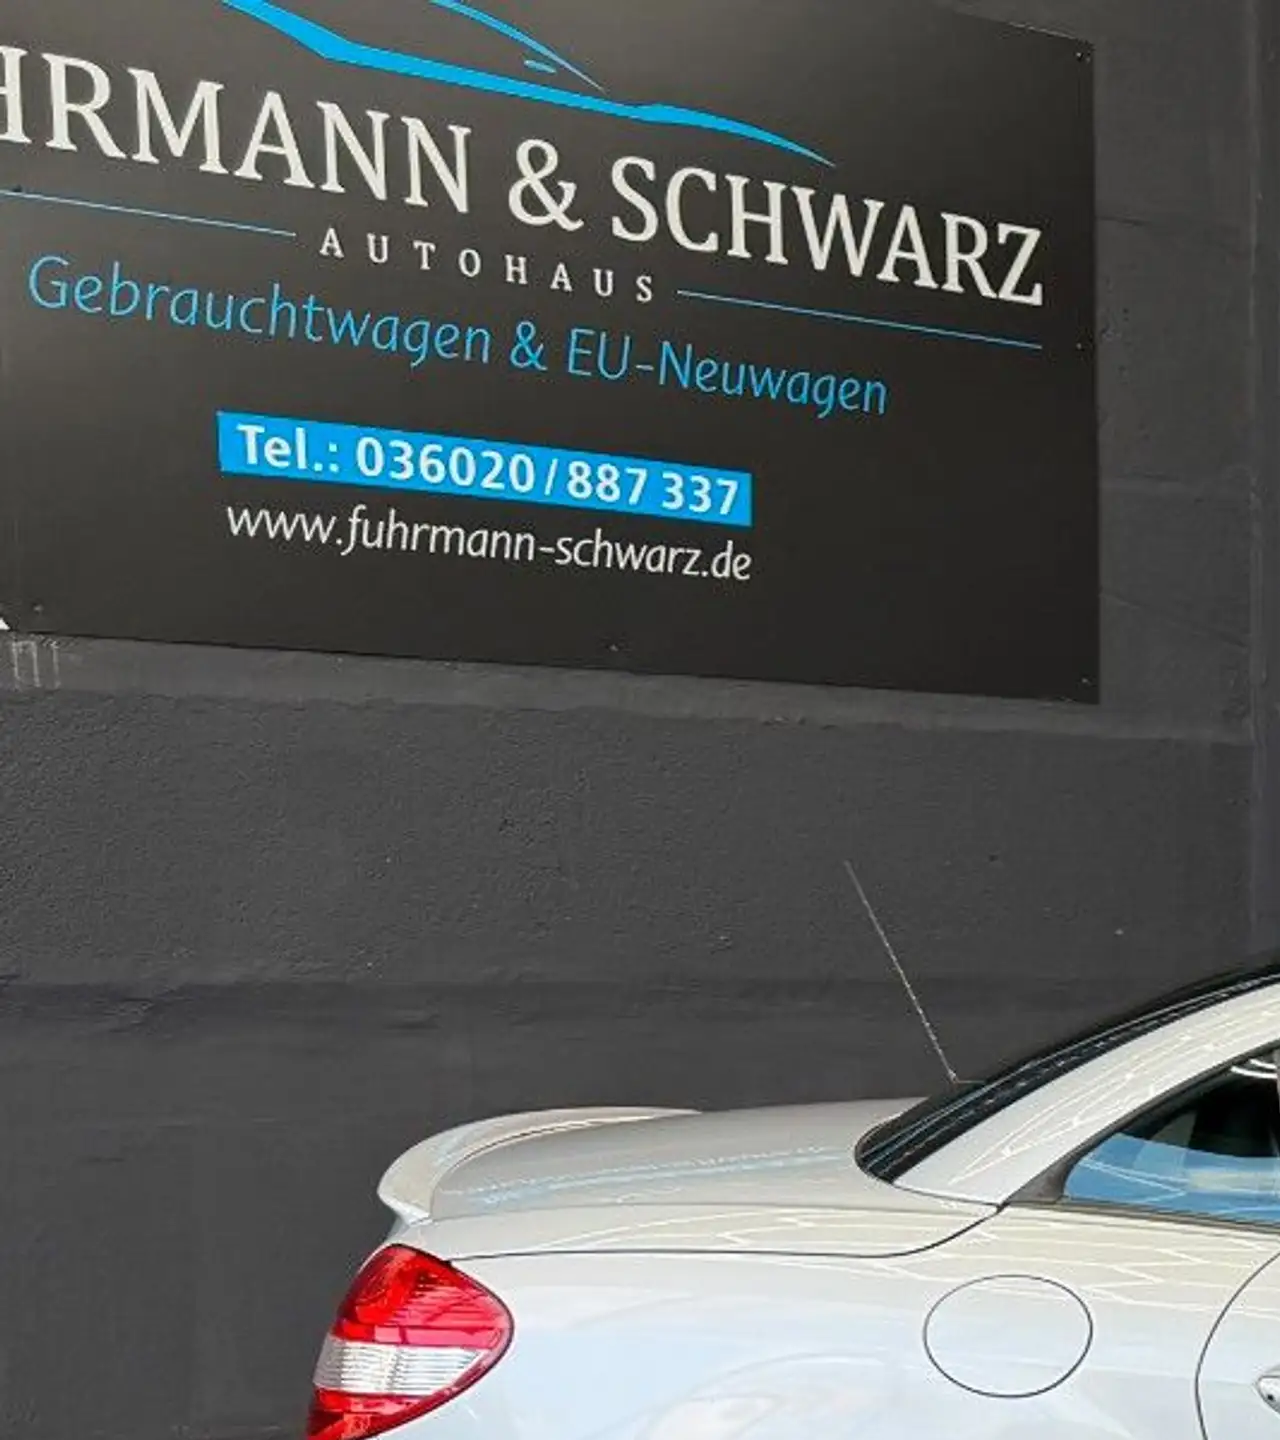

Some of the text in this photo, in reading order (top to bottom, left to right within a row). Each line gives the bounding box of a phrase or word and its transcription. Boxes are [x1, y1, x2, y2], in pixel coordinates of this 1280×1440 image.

[319, 226, 653, 304] AUTOHAUS
[508, 138, 585, 232] &
[611, 155, 1043, 306] SCHWARZ
[28, 255, 888, 416] Gebrauchtwagen & EU-Neuwagen
[236, 424, 341, 474] Tel.:
[661, 472, 740, 516] 337
[226, 503, 752, 580] www.fuhrmann-schwarz.de
